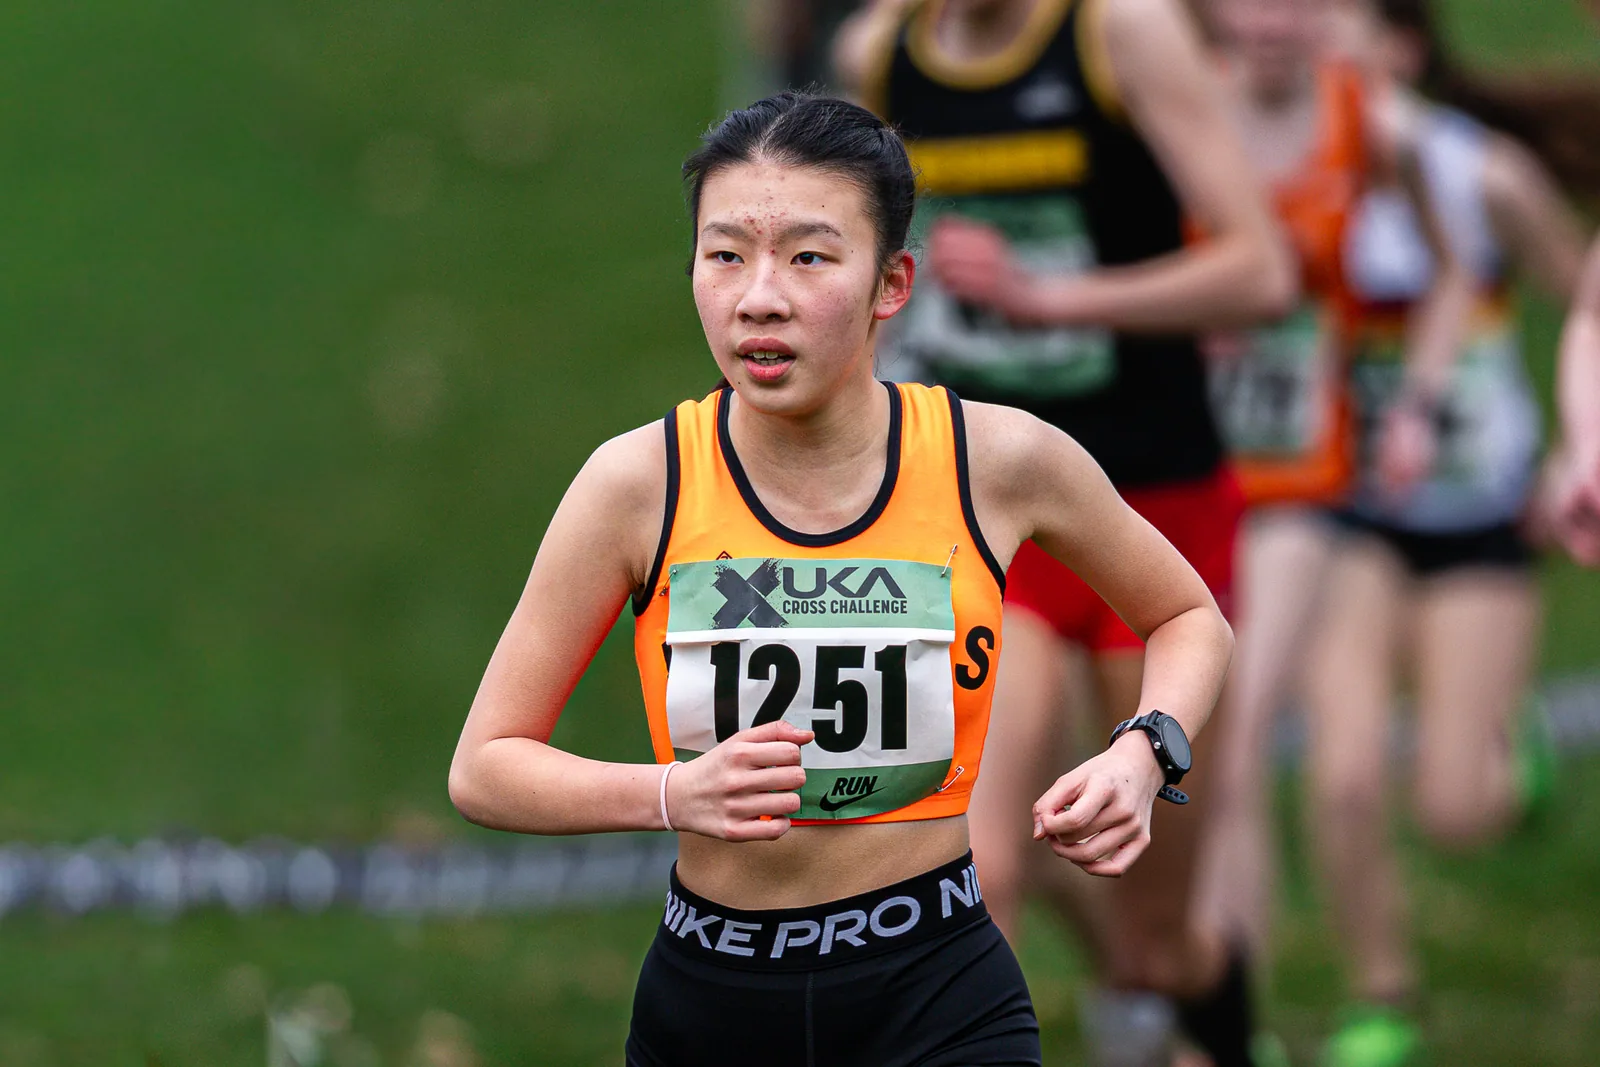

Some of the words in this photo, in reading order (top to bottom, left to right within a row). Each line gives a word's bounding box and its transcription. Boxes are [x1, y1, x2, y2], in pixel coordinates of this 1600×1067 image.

[783, 567, 907, 599] UKA
[782, 600, 826, 615] CROSS
[830, 600, 908, 615] CHALLENGE
[710, 641, 908, 753] 1251
[831, 776, 879, 796] RUN
[664, 890, 762, 956] NIKE
[770, 896, 921, 959] PRO
[939, 862, 982, 919] NI
